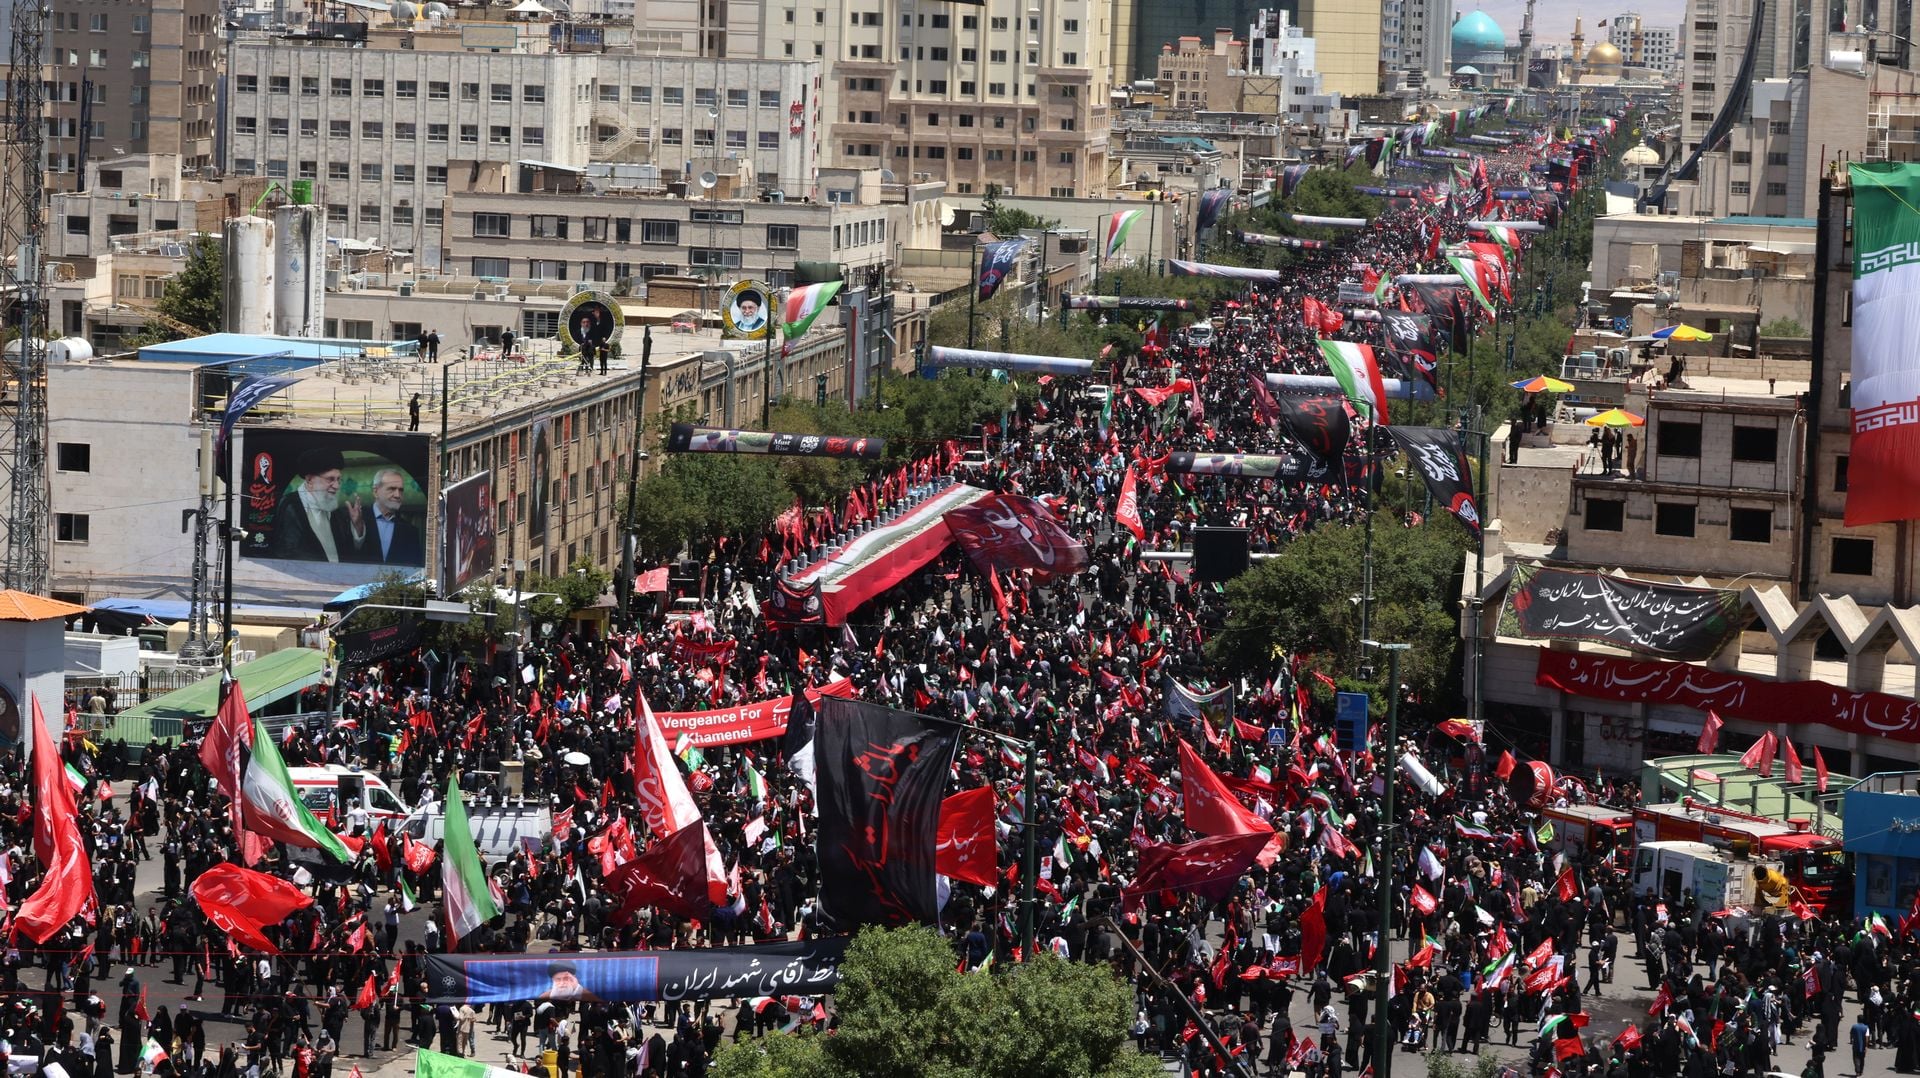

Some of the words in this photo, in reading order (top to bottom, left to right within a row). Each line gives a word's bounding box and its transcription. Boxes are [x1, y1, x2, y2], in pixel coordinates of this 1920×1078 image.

[1550, 580, 1584, 601] الزمان
[1581, 587, 1622, 605] صاحب
[1619, 589, 1657, 611] نثاران
[1650, 597, 1675, 619] جان
[1552, 612, 1600, 630] زهرا
[1594, 618, 1638, 636] حضرت
[1569, 657, 1607, 687] آمده
[1604, 663, 1684, 697] کربلا
[1667, 667, 1737, 703] سفر
[1337, 696, 1351, 713] P
[1831, 693, 1865, 721] آمده
[661, 712, 737, 730] Vengeance
[740, 707, 763, 720] For
[685, 726, 753, 745] Khamenei
[662, 966, 719, 1002] ایران
[720, 957, 763, 999] شهید
[758, 950, 817, 996] آقای
